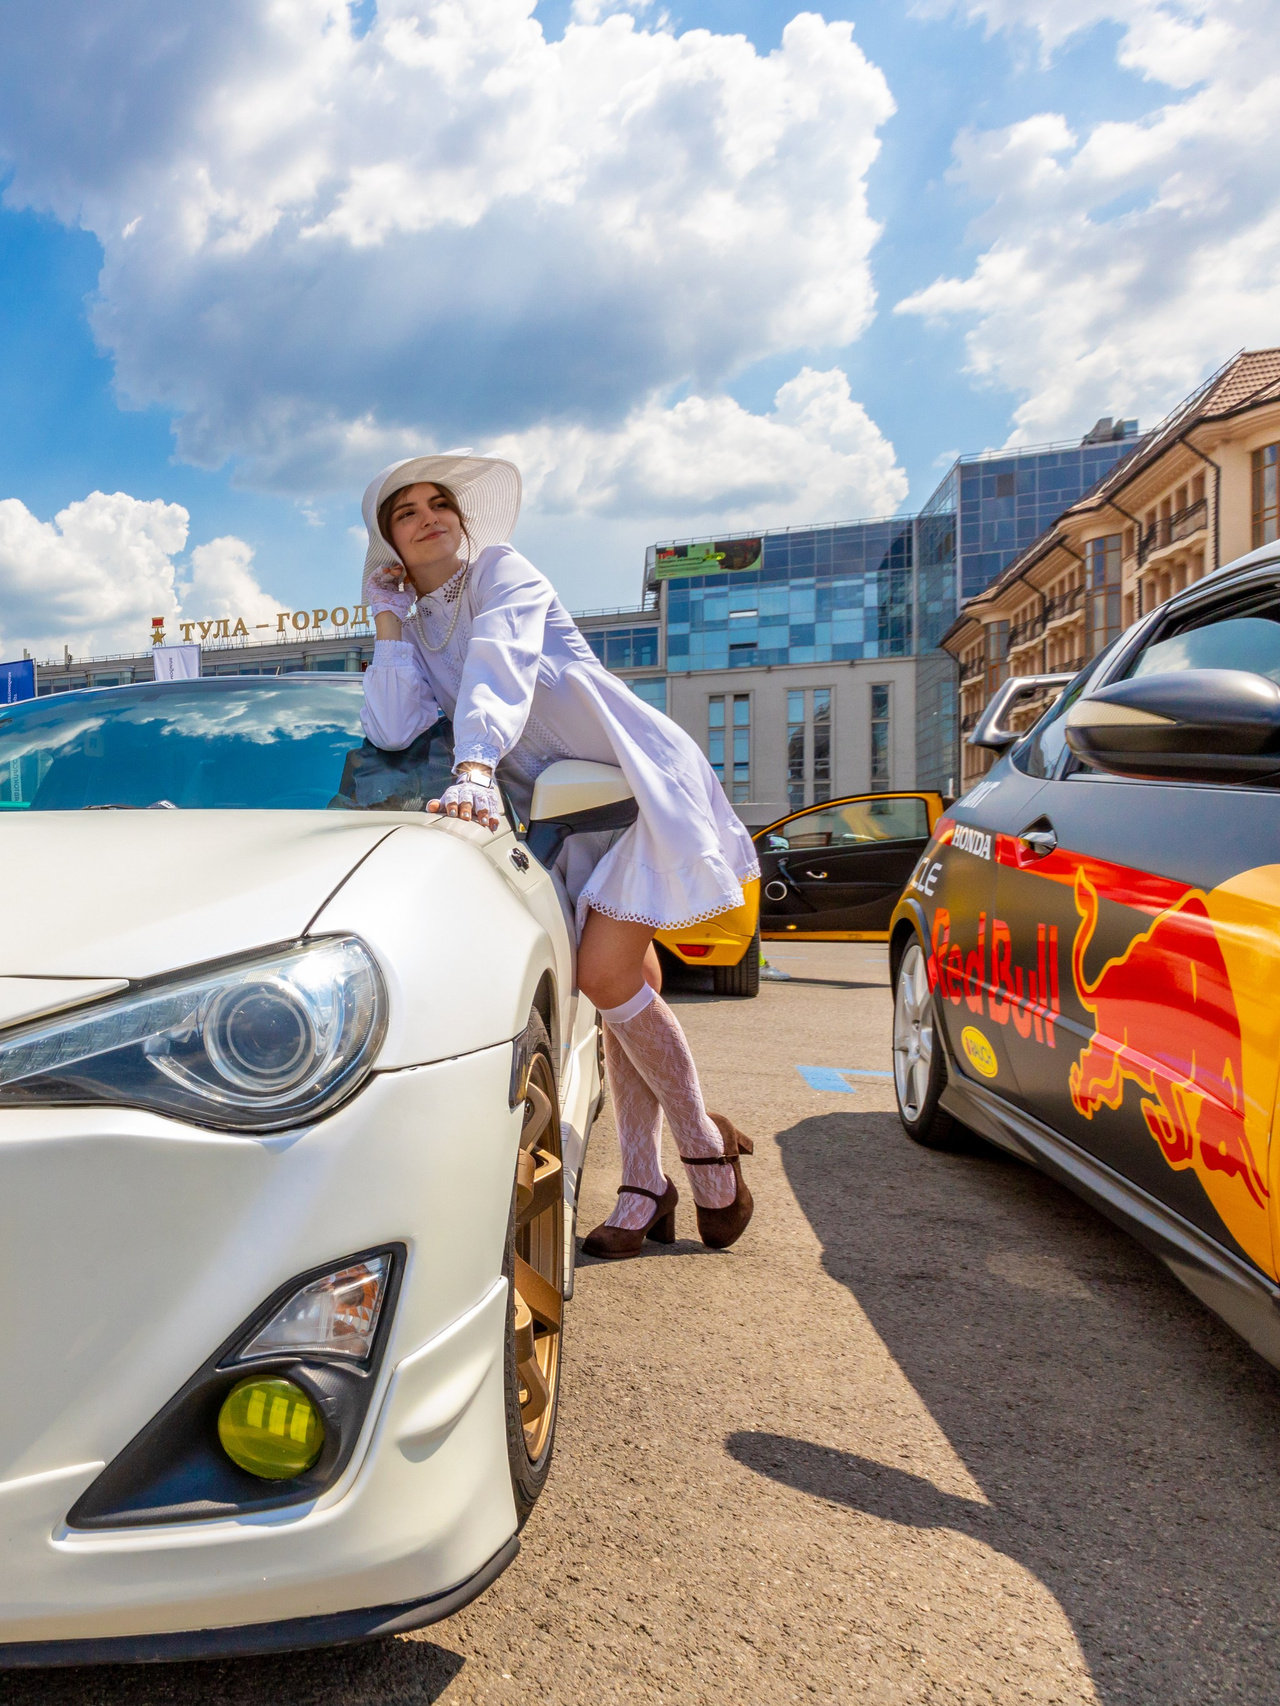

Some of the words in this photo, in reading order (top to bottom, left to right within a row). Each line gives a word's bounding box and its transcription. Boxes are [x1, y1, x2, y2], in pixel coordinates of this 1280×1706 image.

[180, 617, 249, 642] ТУЛА
[276, 605, 370, 632] ГОРОД
[951, 824, 991, 860] HONDA
[927, 908, 986, 1016] Red
[988, 918, 1060, 1049] Bull
